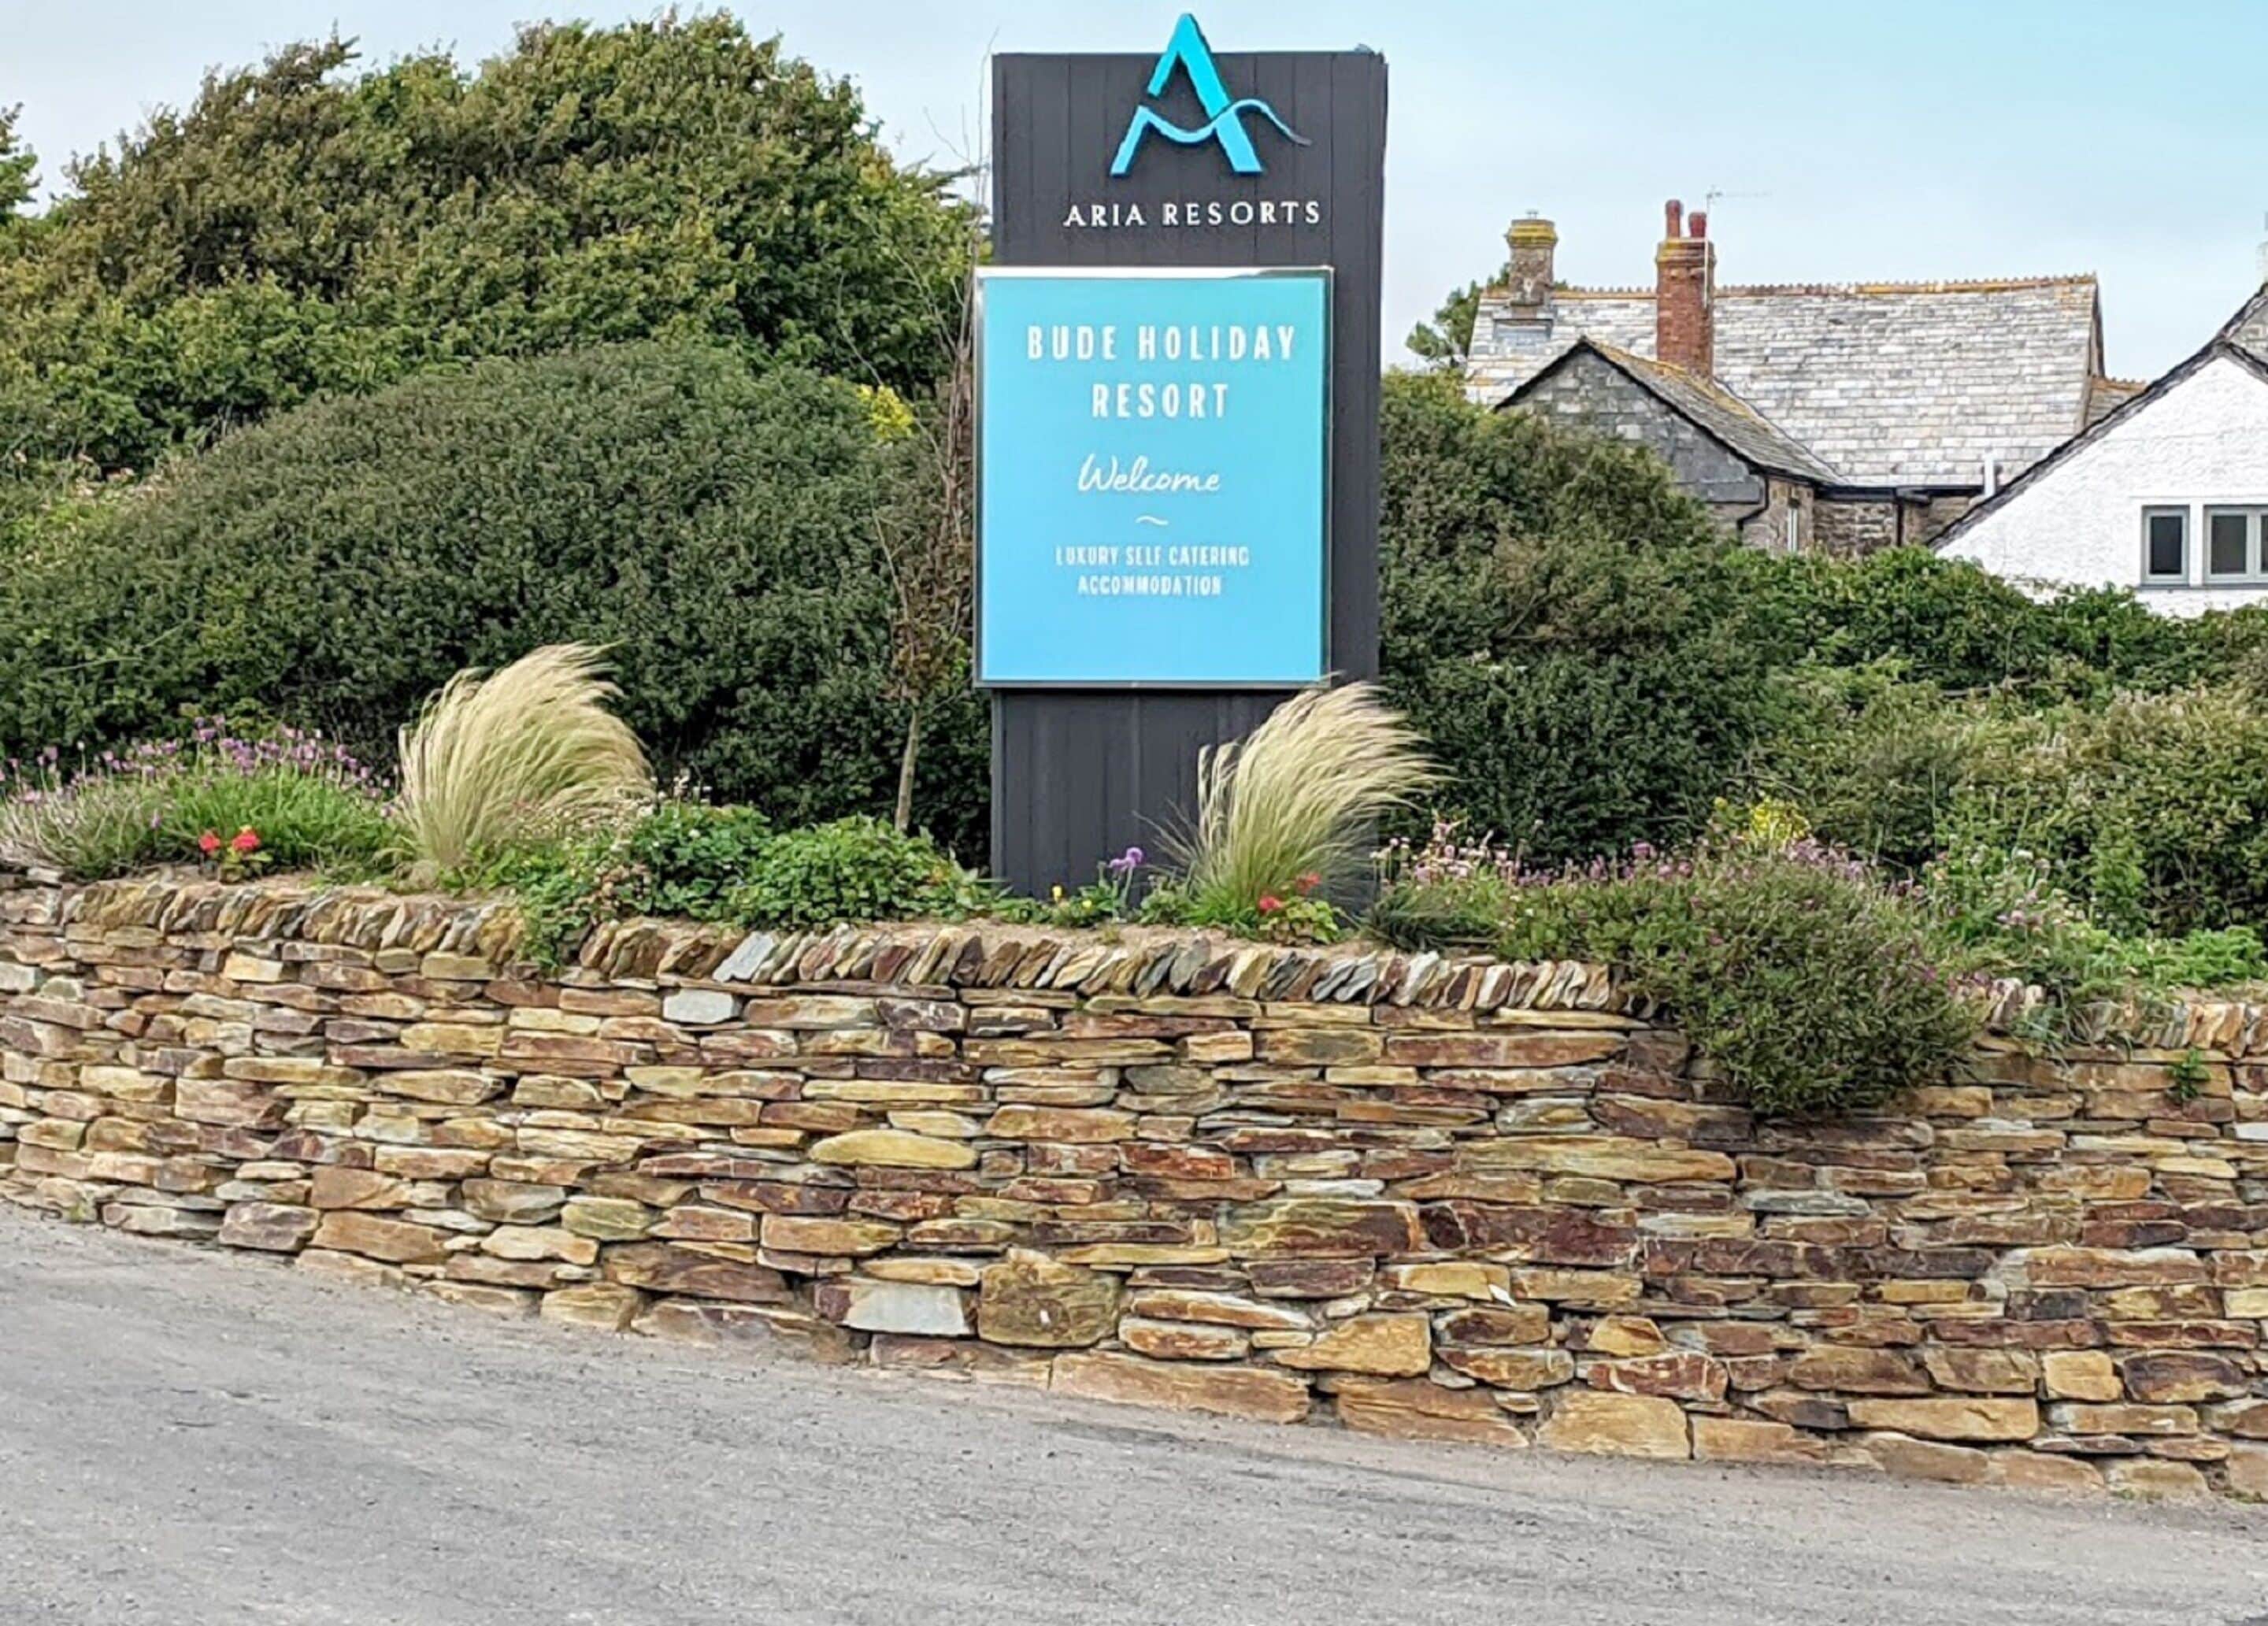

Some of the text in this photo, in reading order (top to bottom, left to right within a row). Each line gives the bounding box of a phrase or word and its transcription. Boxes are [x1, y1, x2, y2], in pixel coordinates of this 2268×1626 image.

[1062, 200, 1321, 228] ARIA RESORTS
[1027, 325, 1295, 361] BUDE HOLIDAY
[1091, 383, 1228, 419] RESORT
[1077, 453, 1221, 492] Welcome
[1055, 546, 1251, 567] LUXURY SELF CATERING
[1077, 575, 1222, 596] ACCOMMODATION
